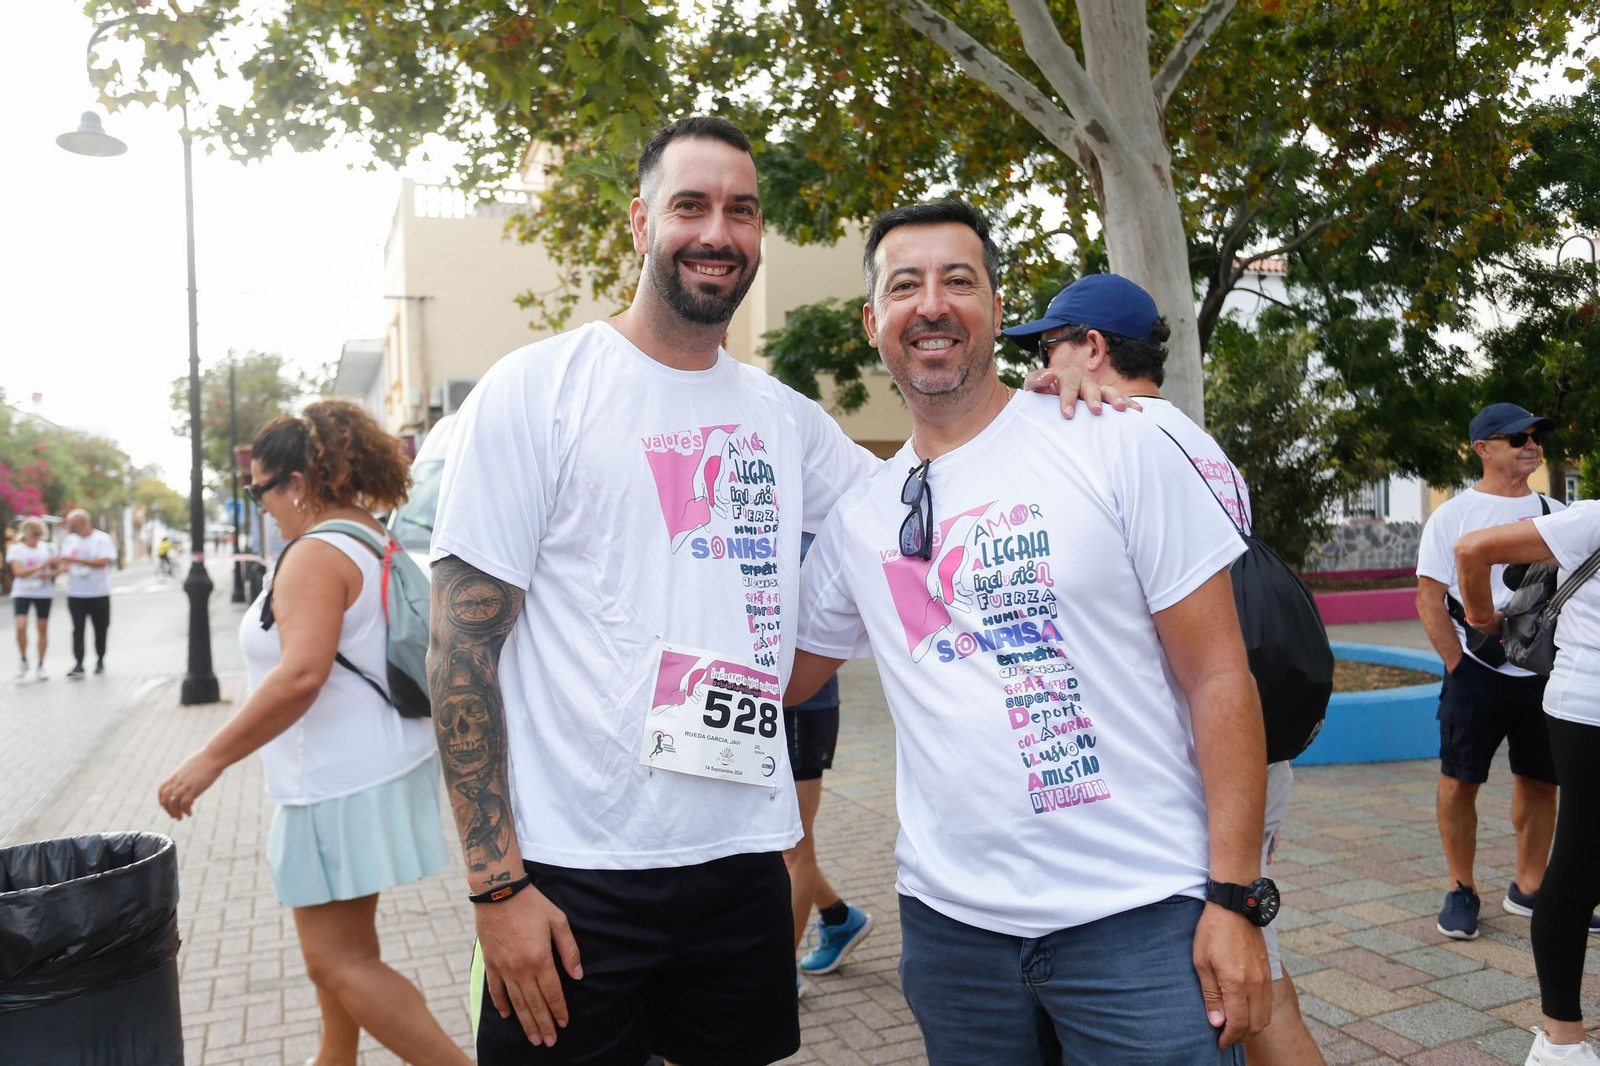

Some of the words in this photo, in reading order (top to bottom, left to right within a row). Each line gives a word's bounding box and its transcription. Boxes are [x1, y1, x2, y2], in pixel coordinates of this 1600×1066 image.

[641, 431, 702, 449] valores
[974, 503, 1043, 546] AMOR
[972, 530, 1051, 572] ALEGRIA
[973, 560, 1055, 594] inclusión
[977, 588, 1057, 611] FUERZA
[982, 602, 1058, 627] HUMILDAD
[936, 619, 1064, 663] SONRISA
[702, 690, 778, 739] 528
[684, 731, 706, 740] RUEDA
[1018, 716, 1093, 750] COLABORAR
